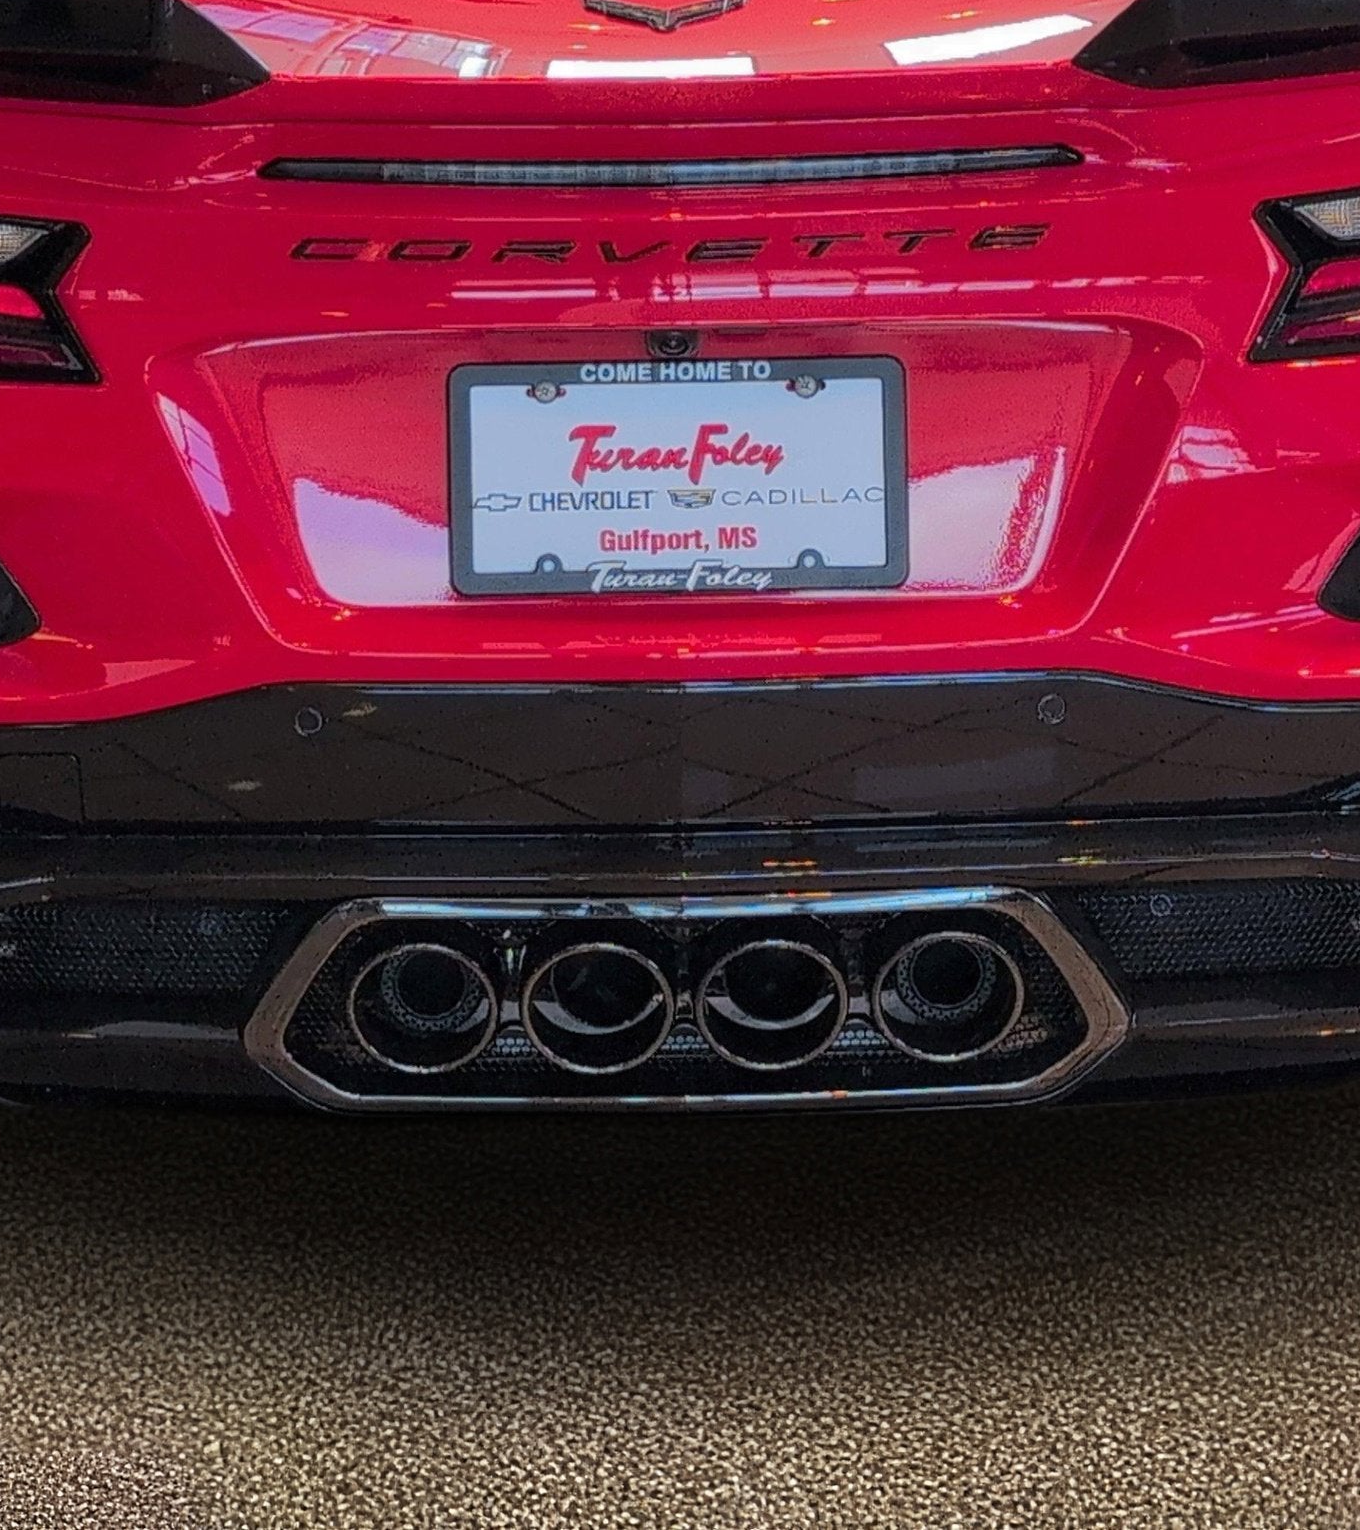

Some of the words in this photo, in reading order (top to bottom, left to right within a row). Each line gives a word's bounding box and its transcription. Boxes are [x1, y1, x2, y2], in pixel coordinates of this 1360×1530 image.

[288, 223, 1051, 265] CORVETTE
[579, 363, 652, 383] COME
[659, 362, 732, 381] HOME
[739, 360, 772, 380] TO
[568, 424, 690, 488] Turan
[688, 423, 784, 486] Foley
[528, 489, 656, 512] CHEVROLET
[721, 486, 884, 506] CADILLAC
[599, 528, 710, 555] Gulfport,
[717, 526, 758, 550] MS
